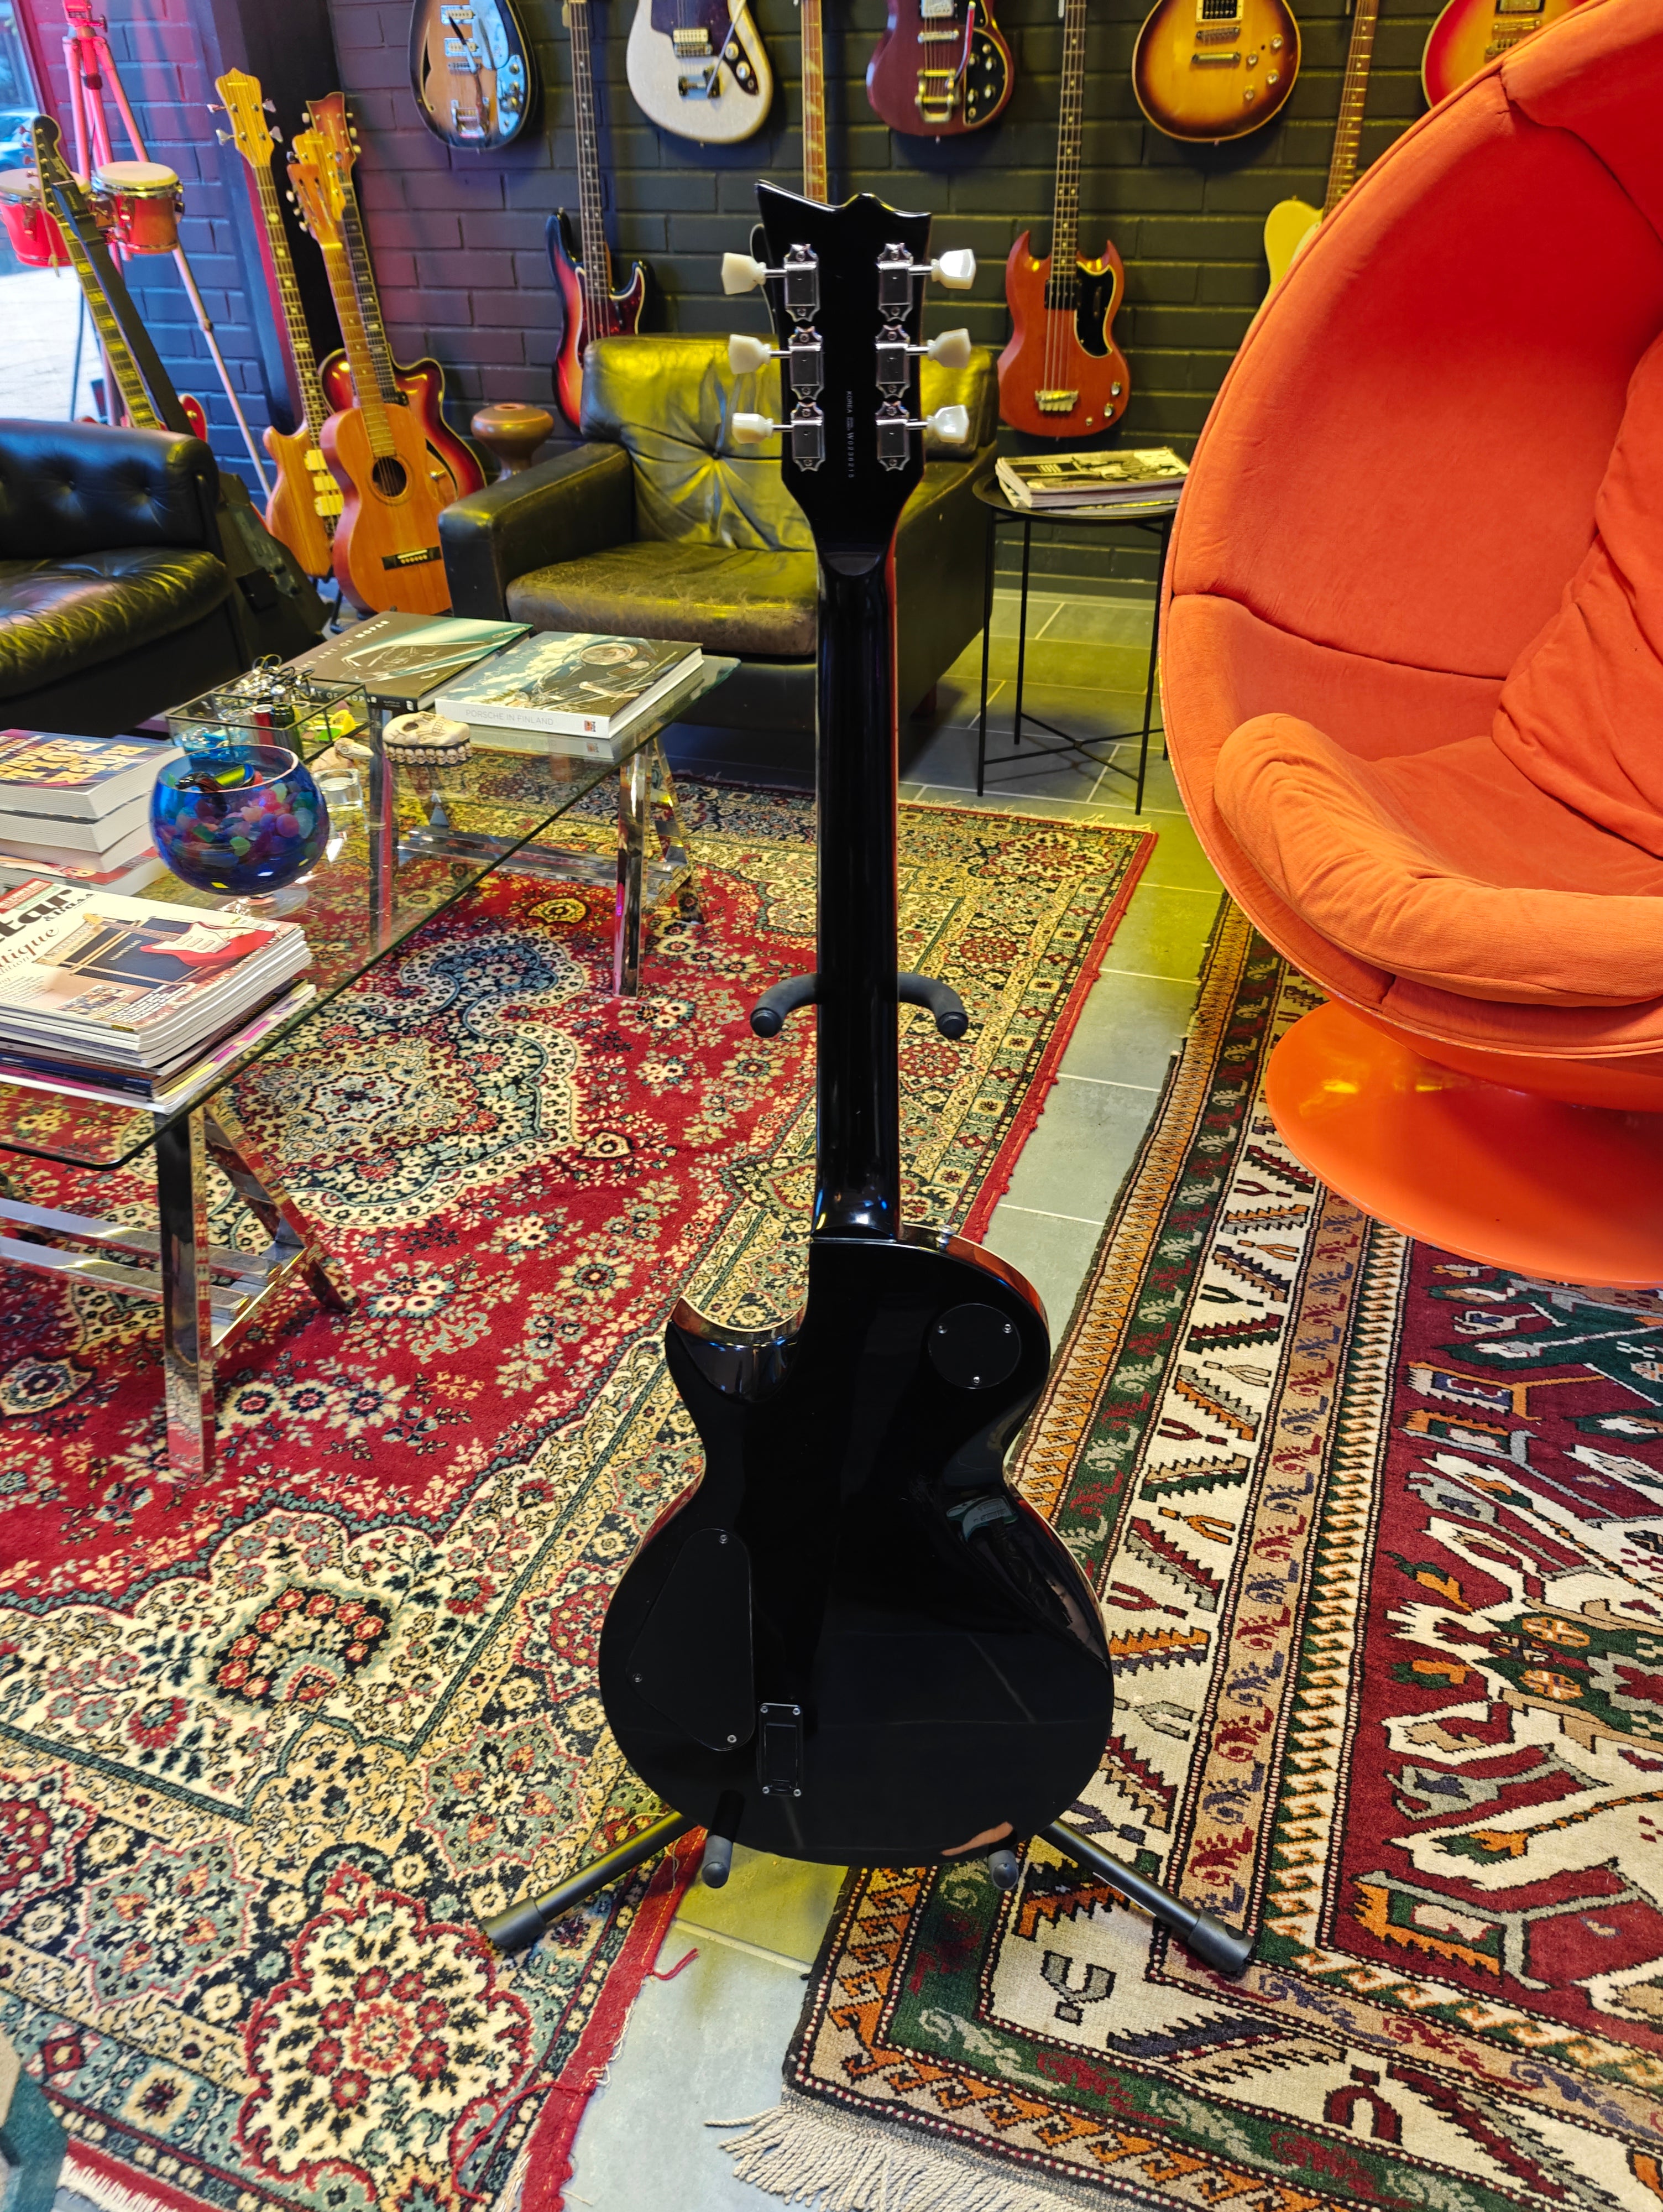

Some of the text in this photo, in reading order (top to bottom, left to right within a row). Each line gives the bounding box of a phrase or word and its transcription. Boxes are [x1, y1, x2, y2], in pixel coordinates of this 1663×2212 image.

[294, 660, 317, 671] THE
[318, 648, 338, 659] ART
[354, 620, 390, 638] MOPAR
[466, 709, 504, 721] PORSCHE
[517, 715, 554, 726] FINLAND
[0, 738, 72, 776] ALMANA
[2, 740, 107, 779] ROLL
[43, 744, 150, 784] ROCK
[0, 889, 72, 943] tar
[54, 893, 95, 916] Bass
[0, 928, 59, 967] tique
